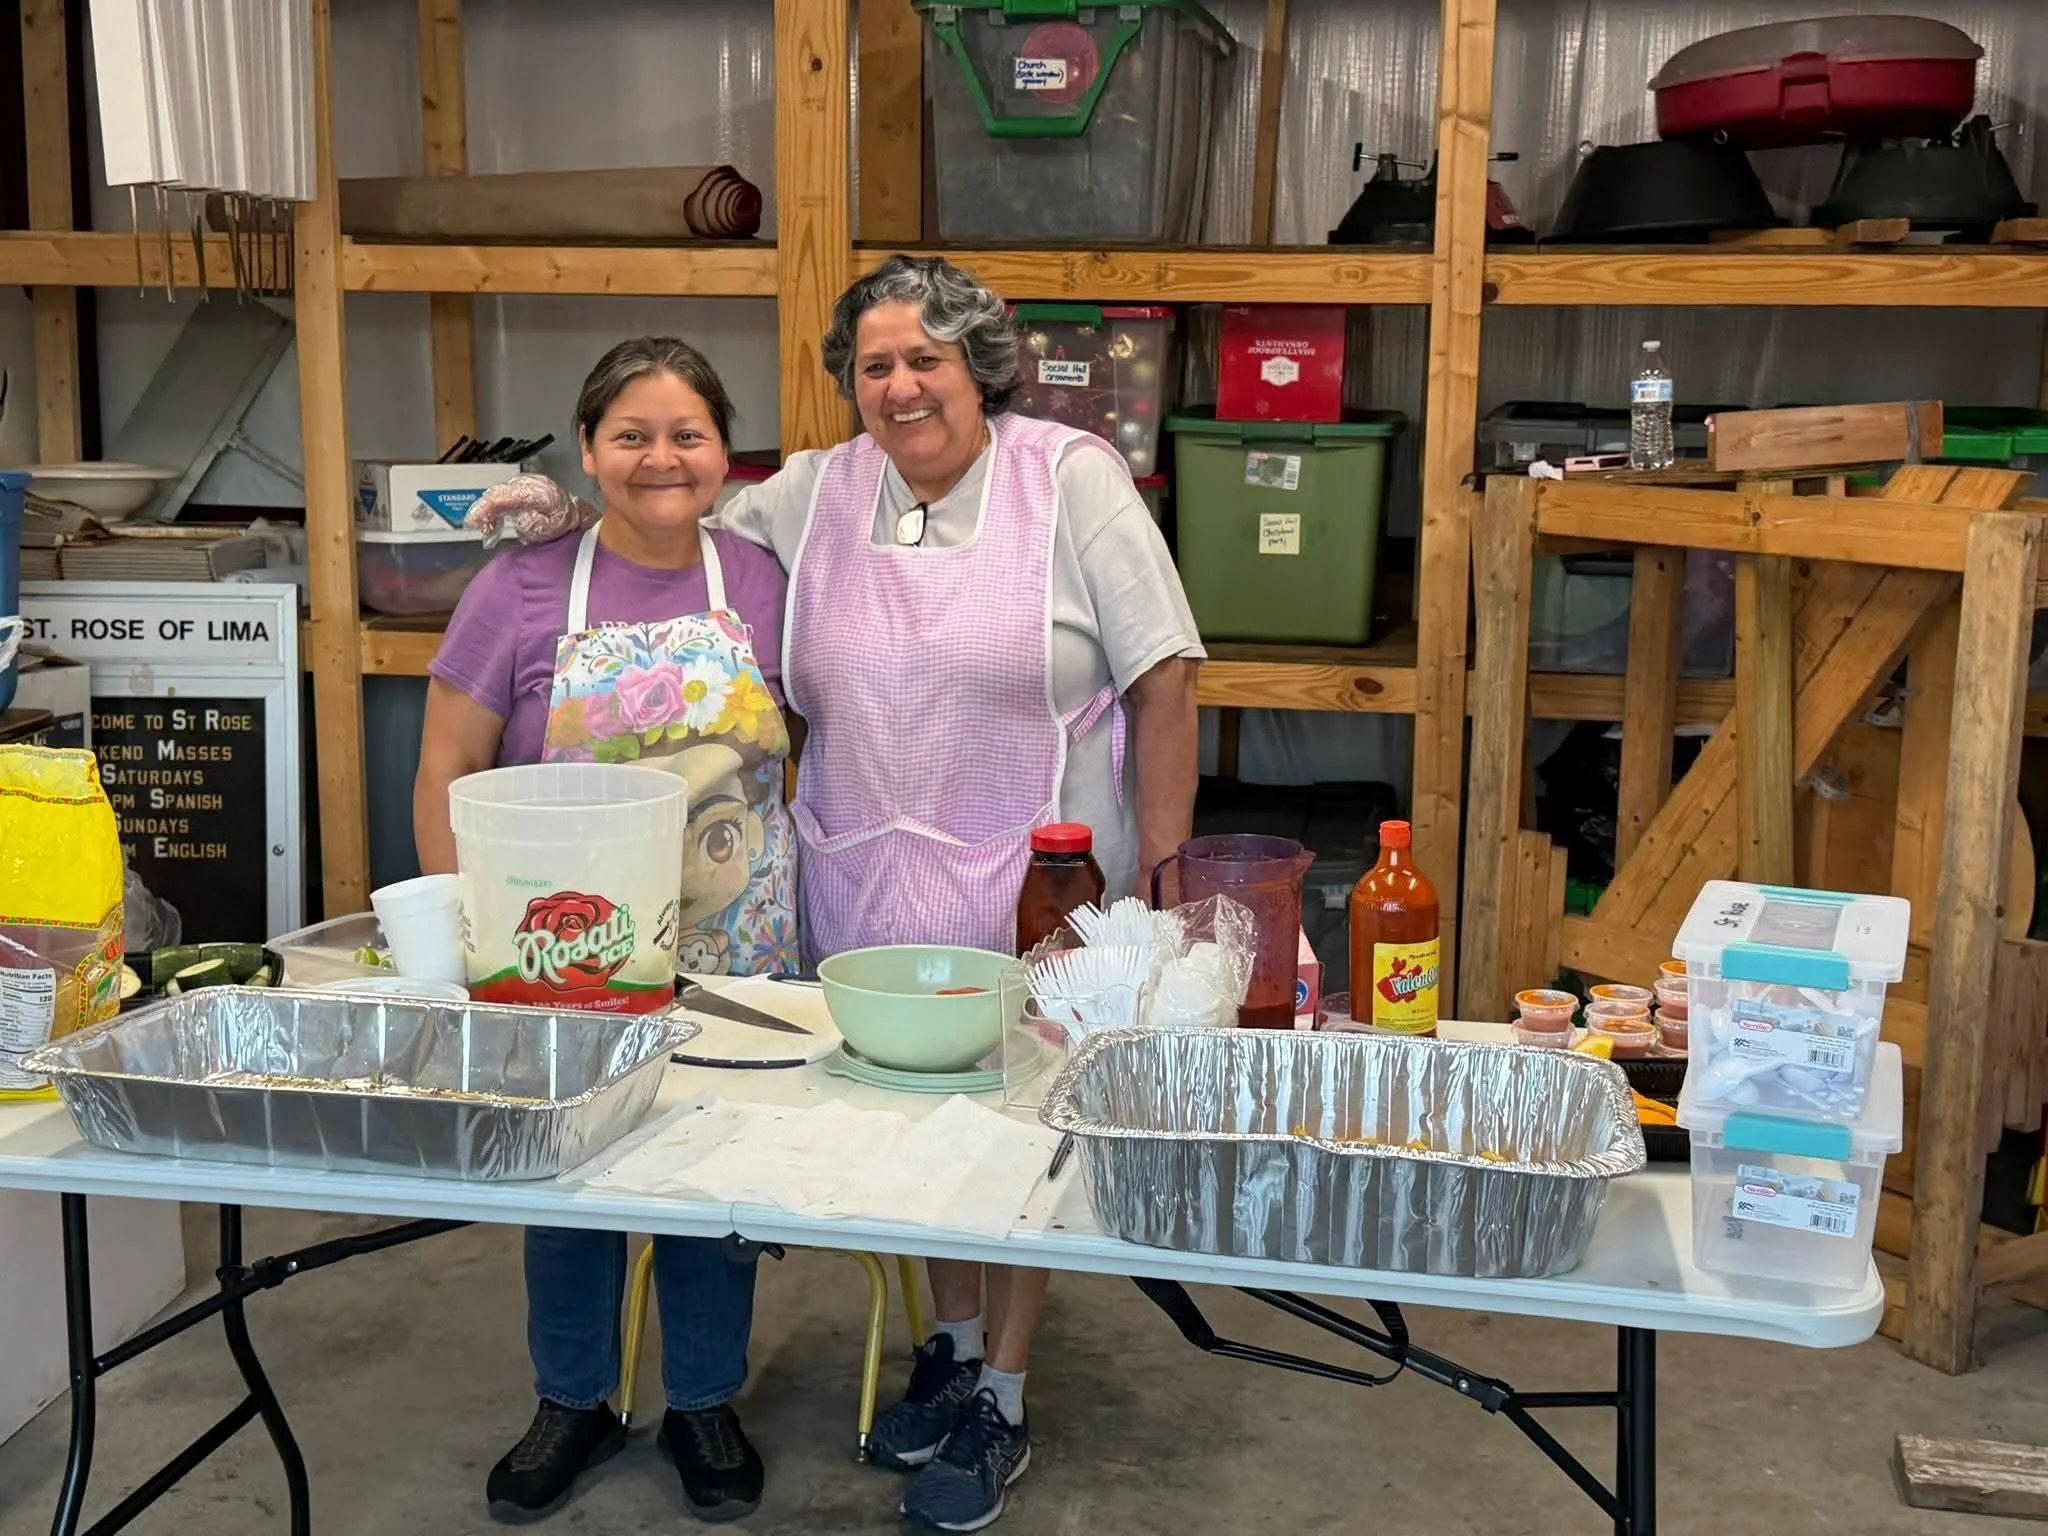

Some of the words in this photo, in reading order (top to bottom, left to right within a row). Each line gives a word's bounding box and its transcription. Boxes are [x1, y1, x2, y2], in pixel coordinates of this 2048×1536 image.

[21, 618, 57, 640] ST.
[71, 618, 145, 640] ROSE
[158, 619, 195, 641] OF
[207, 620, 270, 642] LIMA
[91, 713, 136, 731] COME
[144, 714, 164, 730] TO
[93, 745, 144, 761] KEND
[512, 903, 635, 985] Rosati
[599, 938, 635, 970] ICE
[552, 1001, 583, 1010] Years
[594, 995, 630, 1009] Smiles!
